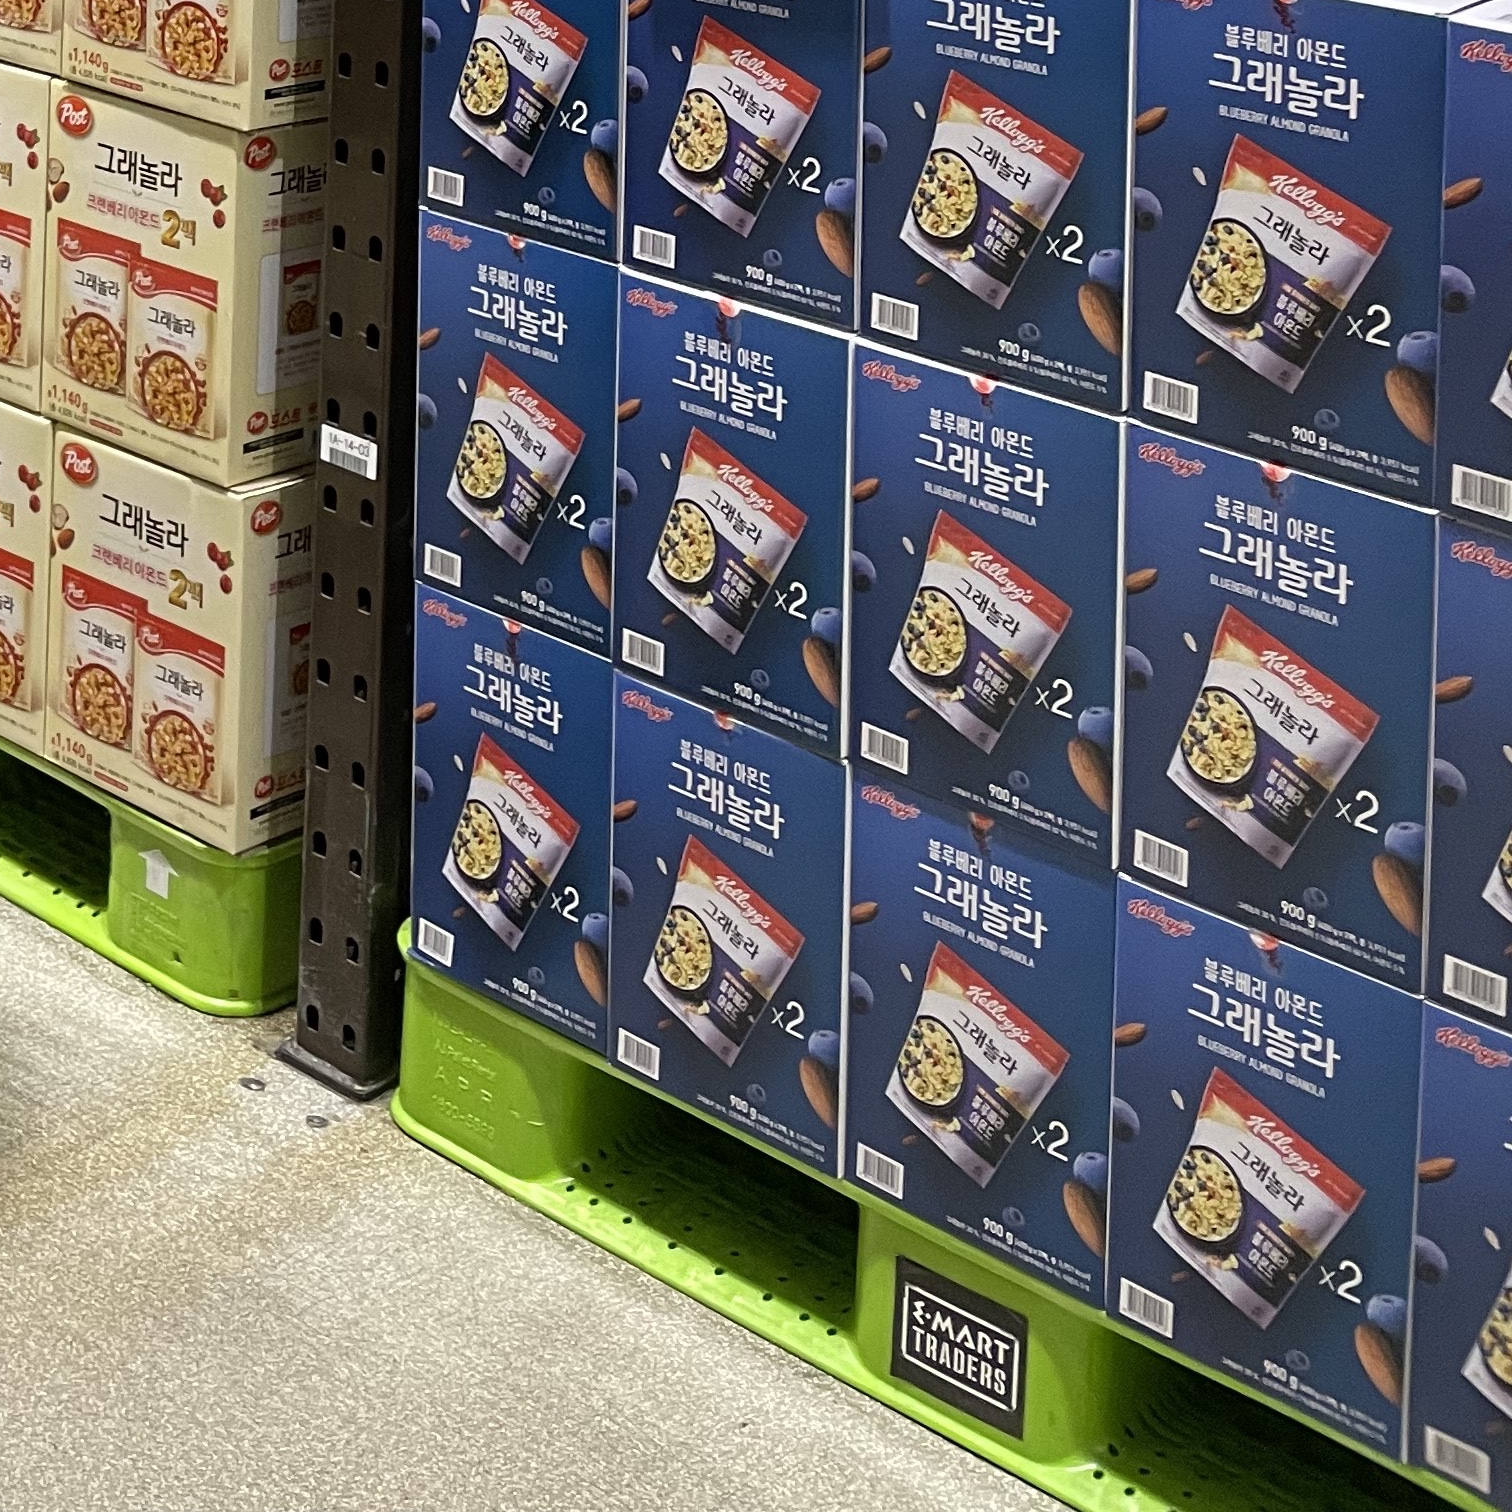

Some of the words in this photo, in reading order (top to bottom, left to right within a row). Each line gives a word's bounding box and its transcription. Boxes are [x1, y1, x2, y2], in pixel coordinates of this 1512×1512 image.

[731, 47, 787, 92] Kellogg's
[1224, 24, 1289, 57] 블루베리
[1297, 36, 1347, 69] 아몬드
[59, 105, 89, 126] Post
[1208, 52, 1365, 120] 그래놀라
[981, 105, 1047, 155] Kellogg's
[1218, 103, 1269, 126] BLUEBERRY
[1271, 113, 1306, 134] ALMOND
[94, 142, 184, 197] 그래놀라
[1269, 172, 1347, 228] Kellogg's
[467, 286, 569, 346] 그래놀라
[684, 332, 732, 365] 블루베리
[737, 347, 774, 378] 아몬드
[672, 354, 788, 423] 그래놀라
[63, 451, 95, 476] Post
[930, 407, 984, 442] 블루베리
[991, 426, 1034, 460] 아몬드
[1291, 424, 1317, 444] 900
[915, 431, 1050, 508] 그래놀라
[98, 493, 190, 558] 그래놀라
[1215, 495, 1279, 536] 블루베리
[1287, 516, 1336, 555] 아몬드
[968, 549, 1034, 606] Kellogg's
[1199, 521, 1354, 606] 그래놀라
[463, 664, 563, 736] 그래놀라
[1260, 649, 1335, 711] Kellogg's
[668, 762, 785, 841] 그래놀라
[929, 838, 983, 880] 블루베리
[990, 862, 1032, 901] 아몬드
[914, 862, 1048, 949] 그래놀라
[1204, 957, 1268, 1002] 블루베리
[1275, 988, 1324, 1029] 아몬드
[1188, 982, 1342, 1079] 그래놀라
[1247, 1114, 1320, 1180] Kellogg's
[911, 1325, 1007, 1396] TRADERS
